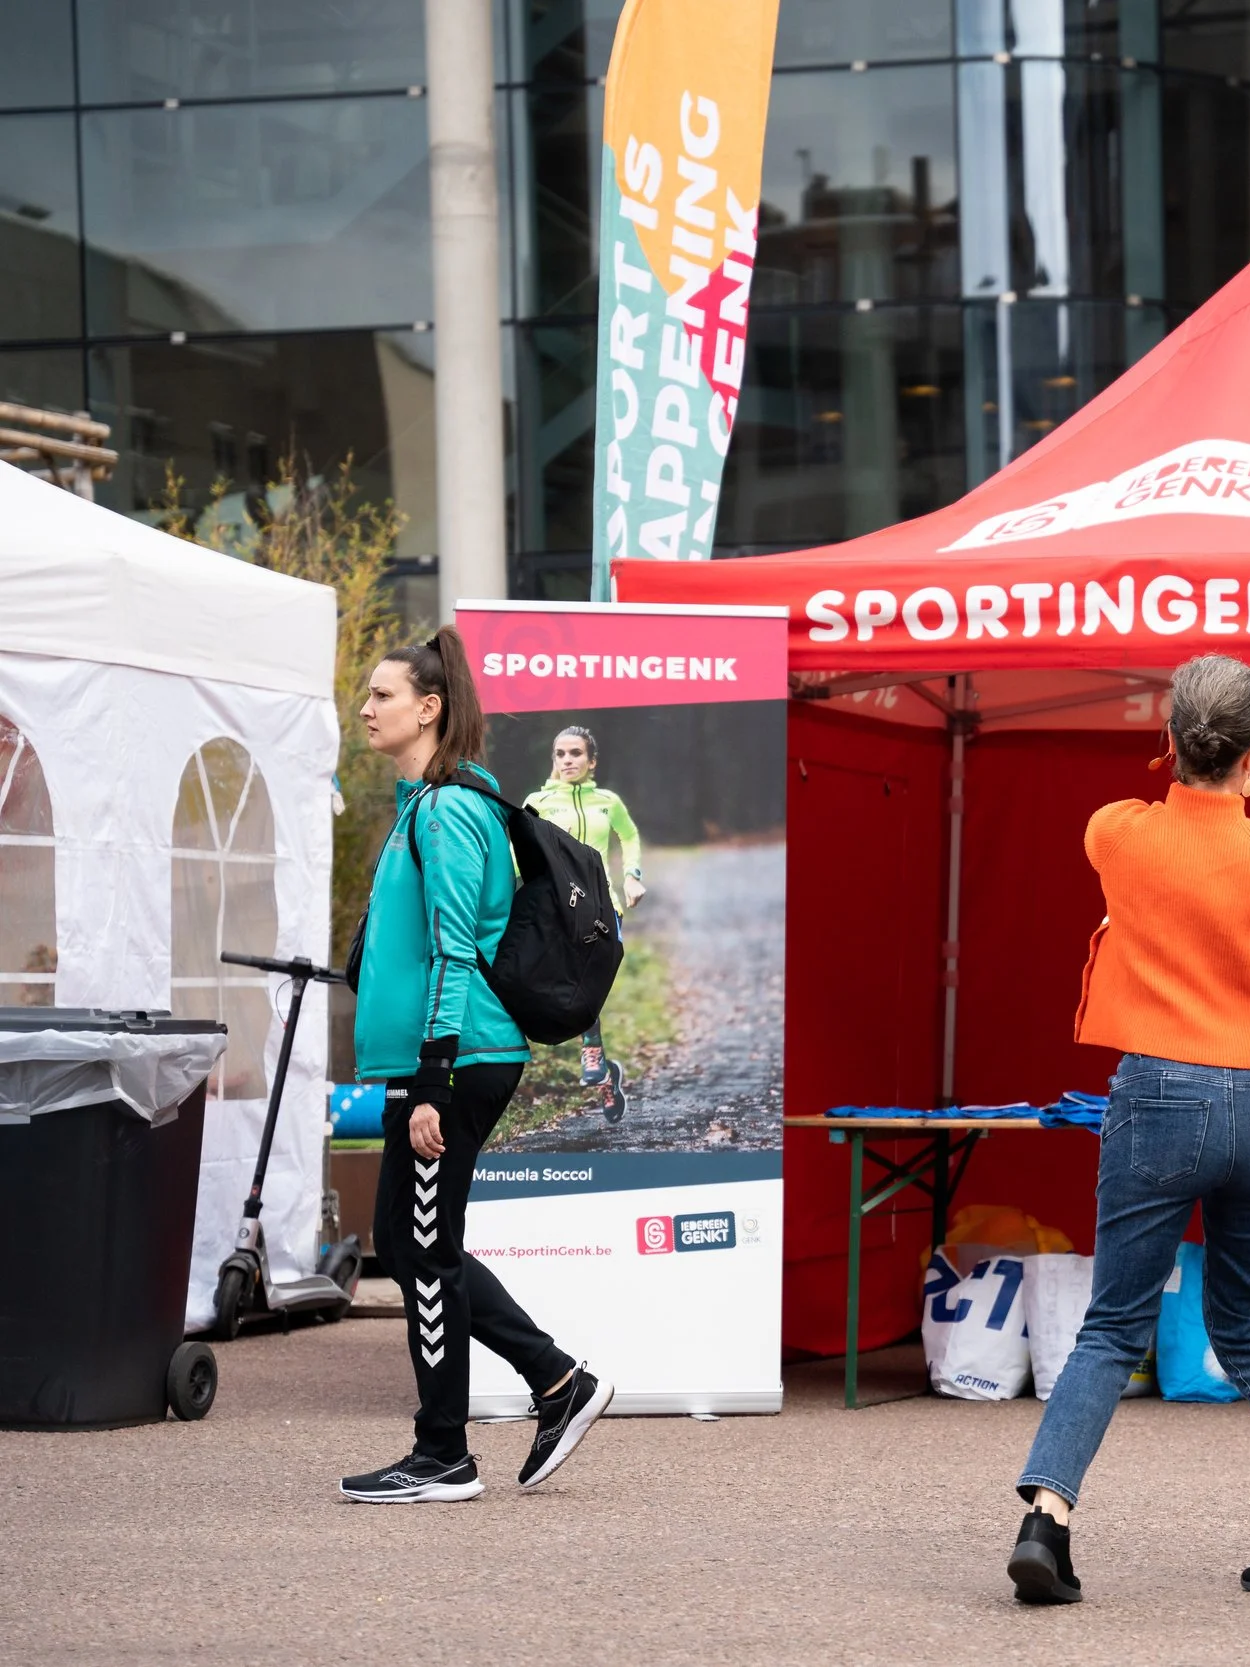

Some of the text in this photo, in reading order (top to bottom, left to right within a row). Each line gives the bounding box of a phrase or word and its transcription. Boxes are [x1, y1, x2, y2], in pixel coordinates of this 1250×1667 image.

[619, 133, 663, 231] IS
[482, 652, 738, 681] SPORTINGENK
[472, 1167, 593, 1182] Manuela Soccol
[681, 1229, 729, 1245] GENKT
[469, 1246, 612, 1259] www.SportinGenk.be
[954, 1374, 1000, 1391] ACTION
